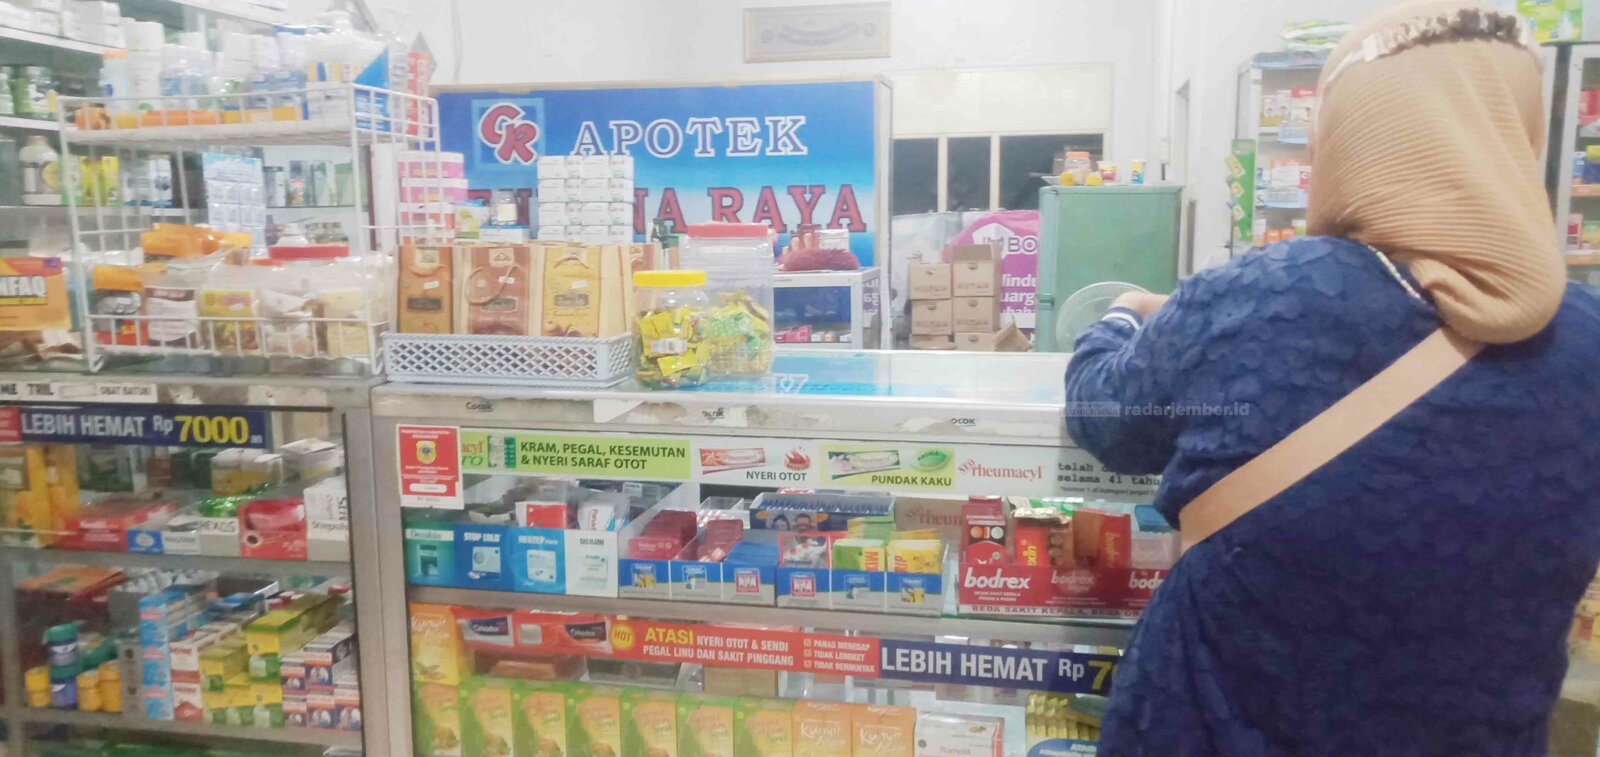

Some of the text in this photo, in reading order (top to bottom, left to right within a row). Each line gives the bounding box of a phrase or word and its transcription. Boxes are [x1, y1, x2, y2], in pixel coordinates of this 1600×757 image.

[569, 115, 808, 158] APOTEK
[707, 184, 867, 233] RAYA
[20, 413, 75, 434] LEBIH
[80, 415, 145, 437] HEMAT
[153, 415, 174, 435] Rp
[175, 415, 249, 444] 7000
[520, 441, 685, 458] KRAM, PEGAL, KESEMUTAN
[520, 456, 647, 470] & NYERI SARAF OTOT
[1058, 462, 1094, 472] telah
[746, 471, 807, 481] NYERI OTOT
[871, 475, 952, 487] PUNDAK KAKU
[972, 464, 1042, 482] rheumacyl
[1057, 474, 1160, 486] selama 41 tahu
[964, 566, 1032, 589] bodrex
[972, 605, 1001, 613] BEDA
[1005, 606, 1036, 614] SAKIT
[644, 628, 789, 652] ATASI NYERI OTOT & SENDI
[643, 645, 794, 666] PEGAL LINU DAN SAKIT PINGGANG
[813, 650, 833, 659] TIDAK
[814, 661, 833, 670] TIDAK
[881, 647, 1117, 691] LEBIH HEMAT Rp 7
